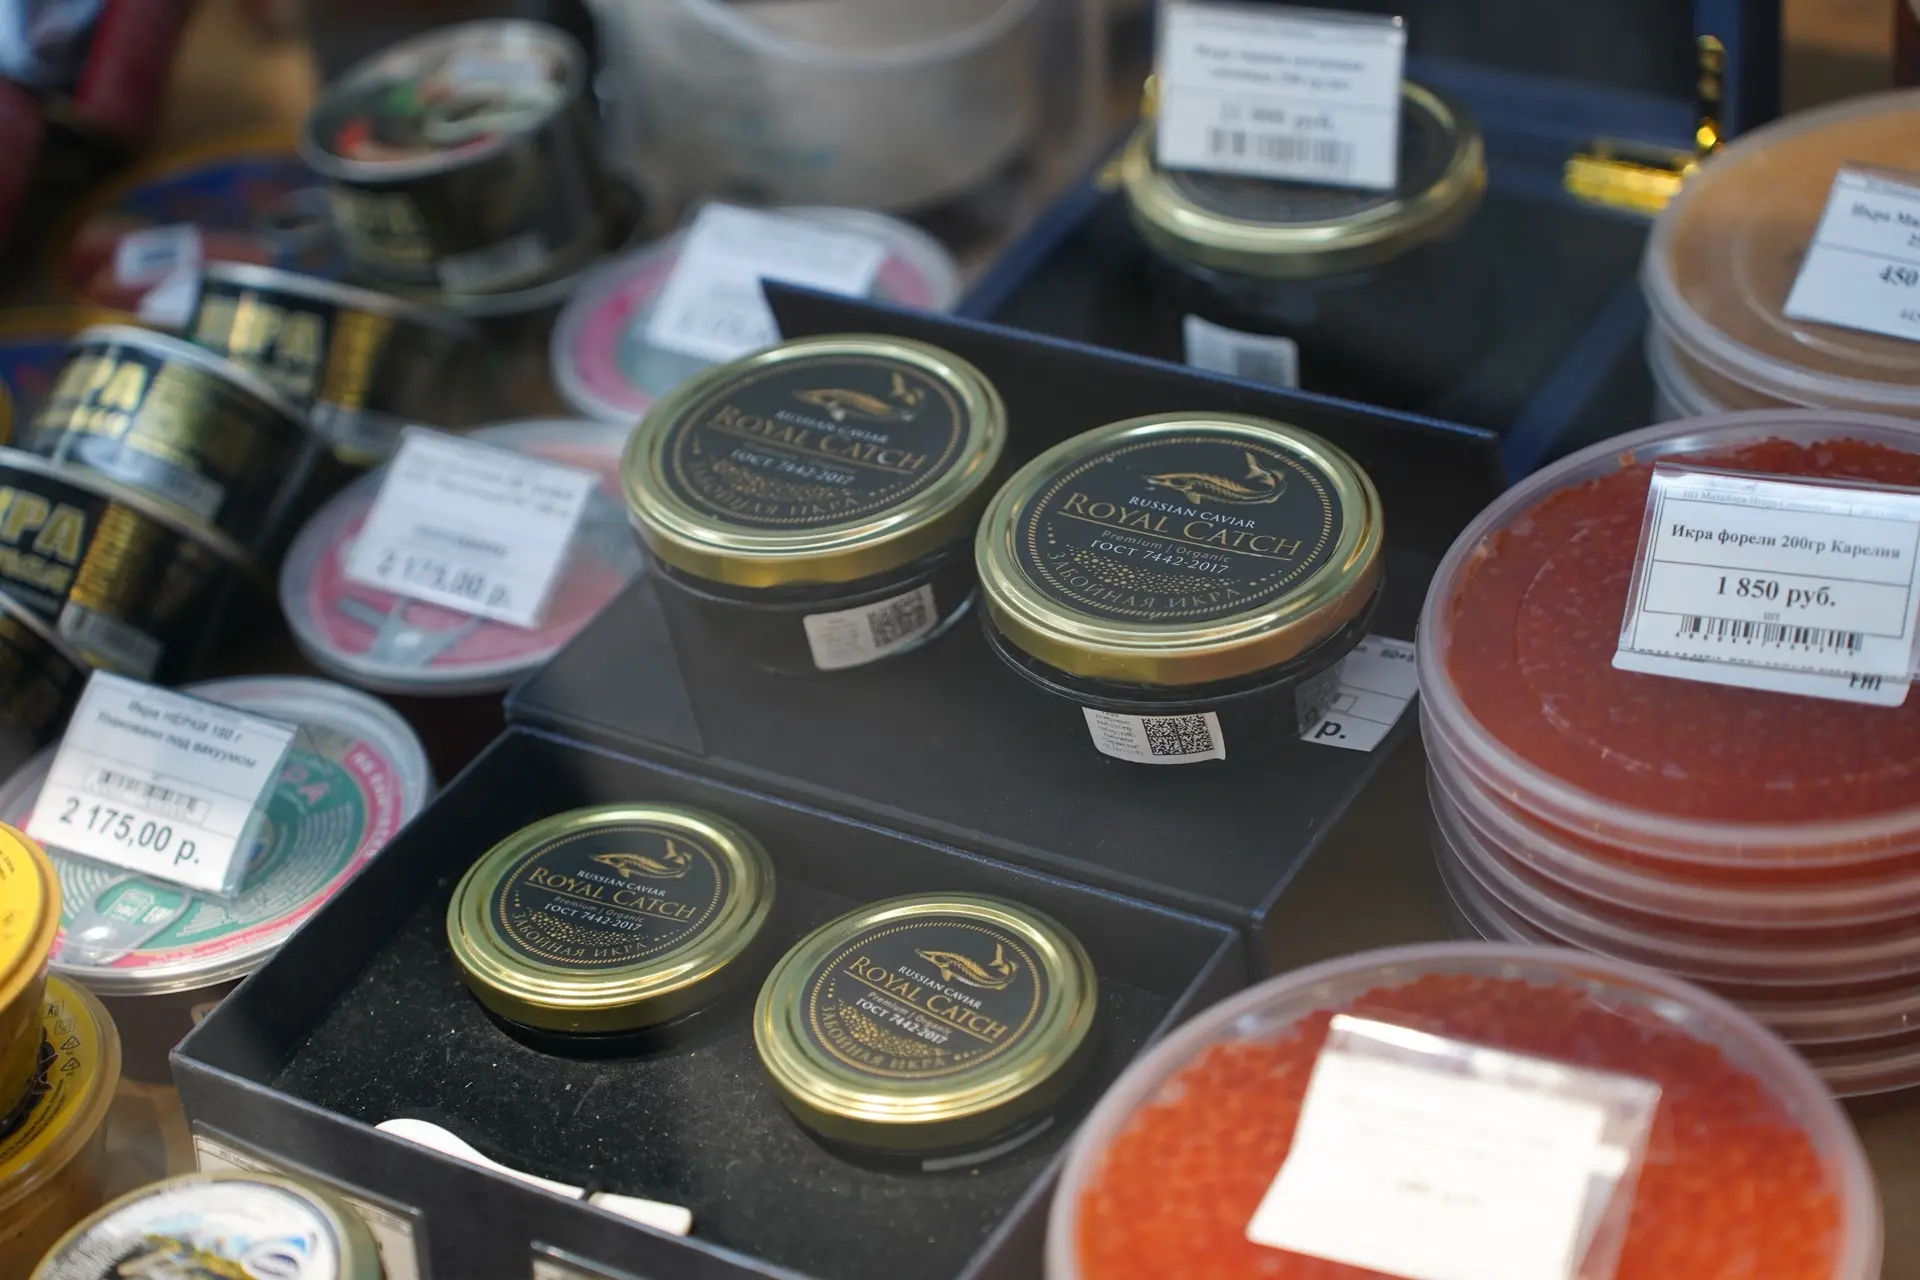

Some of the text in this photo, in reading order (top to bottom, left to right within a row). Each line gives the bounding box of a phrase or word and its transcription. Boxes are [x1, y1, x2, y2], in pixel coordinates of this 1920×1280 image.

[713, 404, 810, 446] ROYAL
[819, 434, 928, 471] CATCH
[1062, 491, 1304, 557] ROYAL CATCH
[1128, 495, 1257, 530] RUSSIAN CAVIAR
[1091, 540, 1230, 575] ГОСТ 7442-2017
[1101, 529, 1232, 564] Premium Organic
[1671, 523, 1901, 560] Икра форели 200гр Карелия
[1045, 549, 1241, 609] ЗАБОЙНАЯ ИКРА
[1716, 576, 1836, 609] 1 850 руб.
[193, 742, 257, 769] вакуумом
[59, 796, 200, 866] 2 175,00 р.
[528, 866, 697, 920] ROYAL CATCH
[577, 869, 667, 898] RUSSIAN CAVIAR
[544, 902, 643, 932] ГОСТ 7442-2017
[594, 941, 648, 959] ИКРА
[848, 955, 1009, 1040] ROYAL CATCH
[898, 965, 982, 1010] RUSSIAN CAVIAR
[855, 997, 949, 1045] ГОСТ 7442-2017
